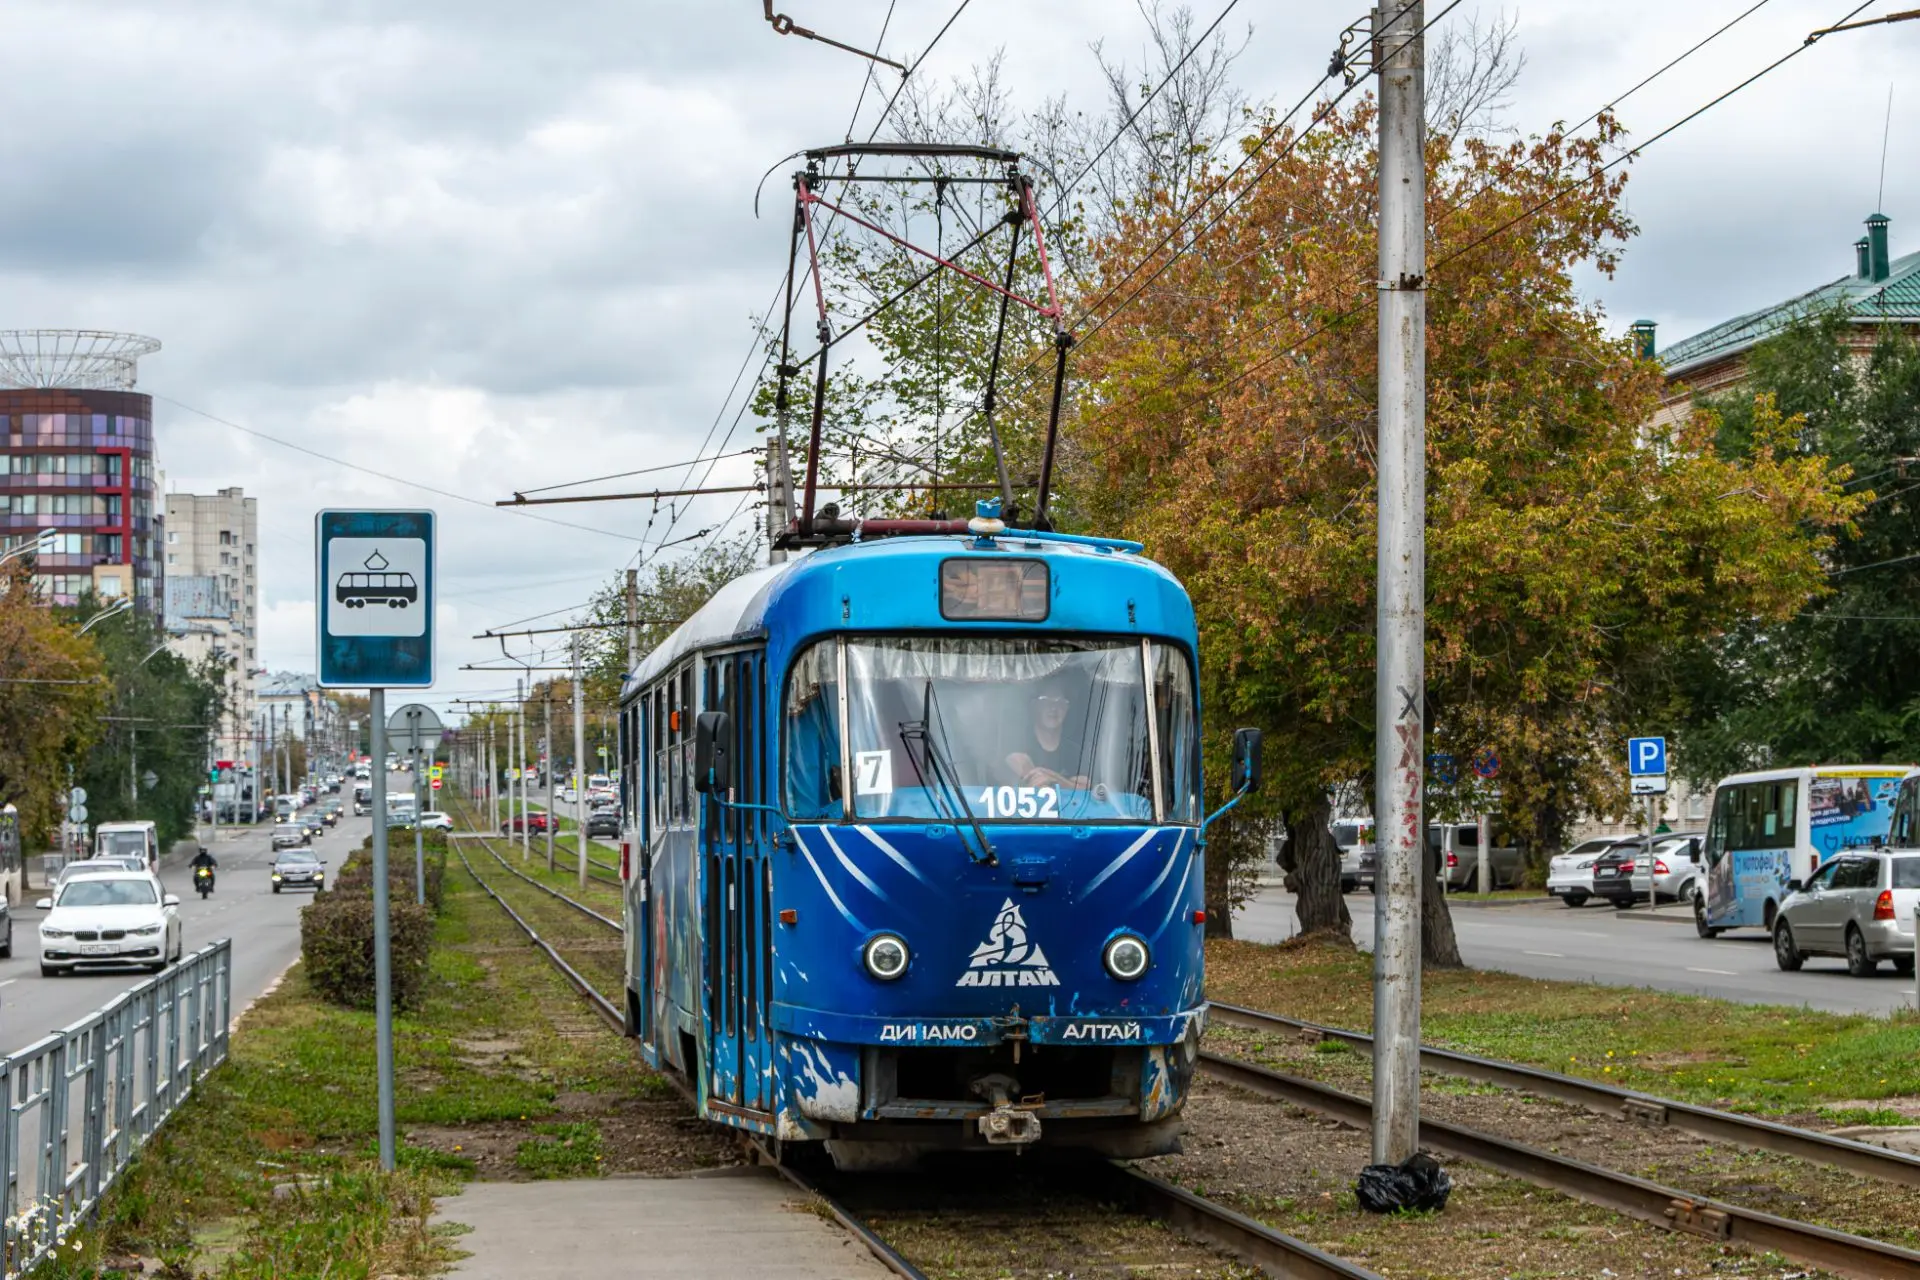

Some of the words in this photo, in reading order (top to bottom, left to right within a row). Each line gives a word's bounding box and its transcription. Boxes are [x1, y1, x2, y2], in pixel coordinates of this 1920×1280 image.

[1639, 742, 1659, 770] P
[864, 756, 882, 788] 7
[979, 785, 1059, 818] 1052
[955, 967, 1061, 987] АЛТАЙ
[1062, 1021, 1141, 1040] АЛТАЙ
